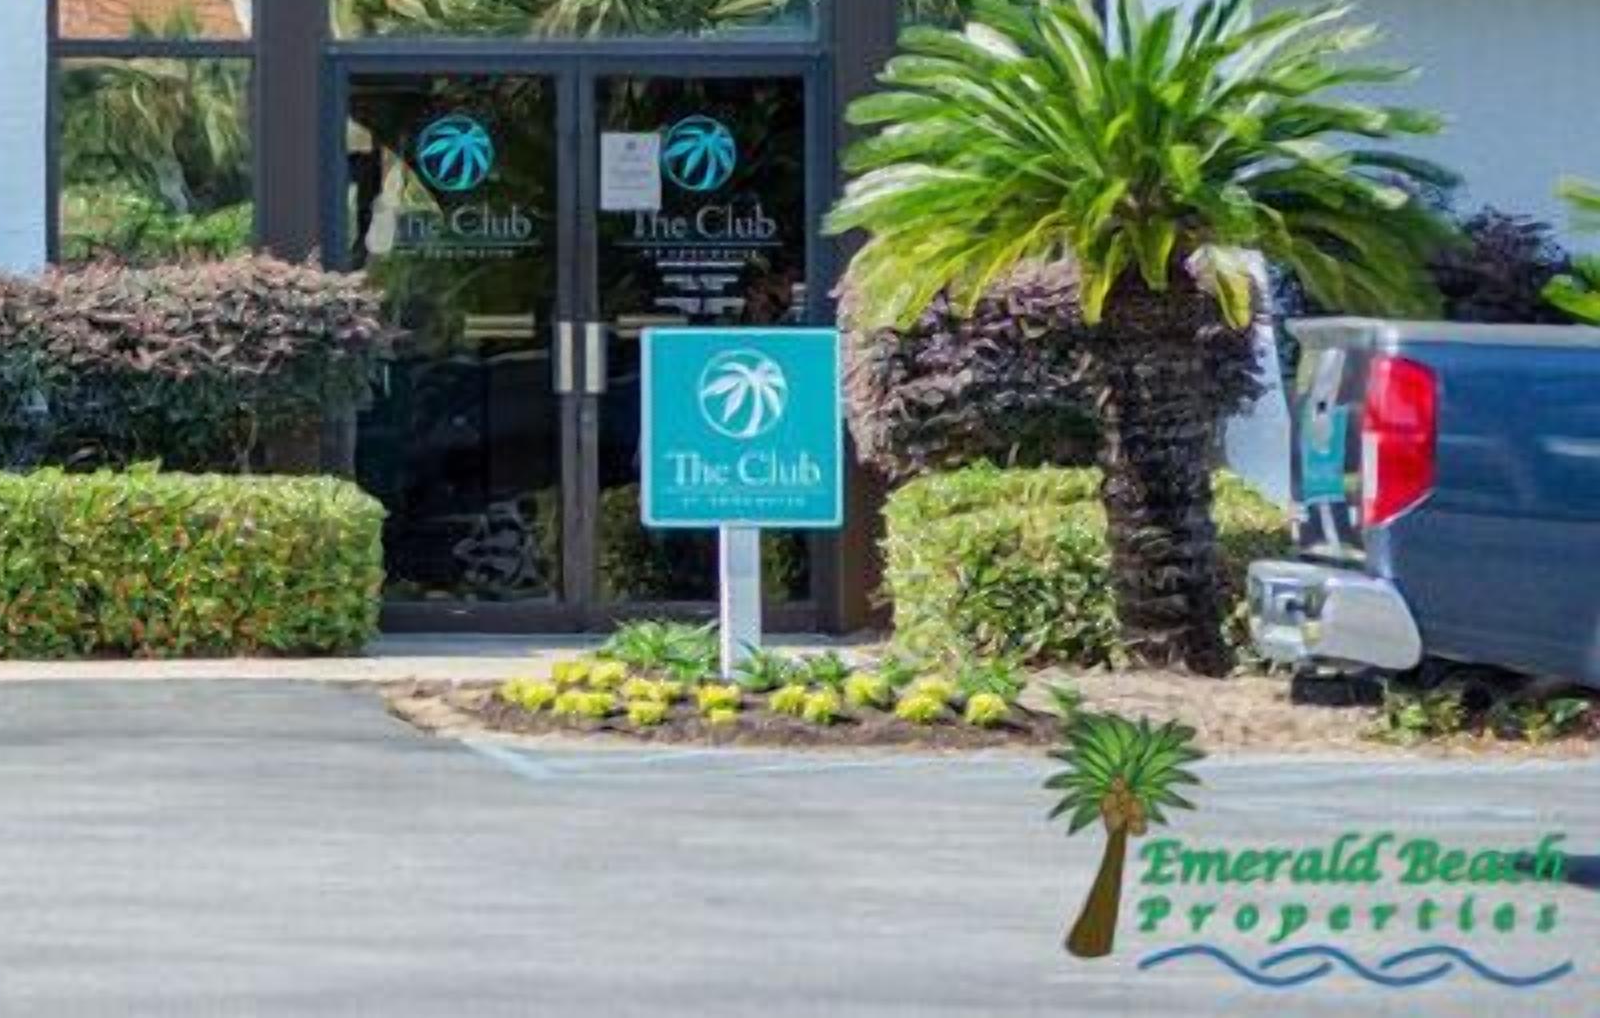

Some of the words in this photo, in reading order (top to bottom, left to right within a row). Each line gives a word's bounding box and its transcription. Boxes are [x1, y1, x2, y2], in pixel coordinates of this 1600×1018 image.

[452, 204, 532, 238] Club
[632, 208, 687, 238] The
[696, 203, 776, 238] Club
[664, 451, 729, 485] The
[737, 449, 821, 485] Club
